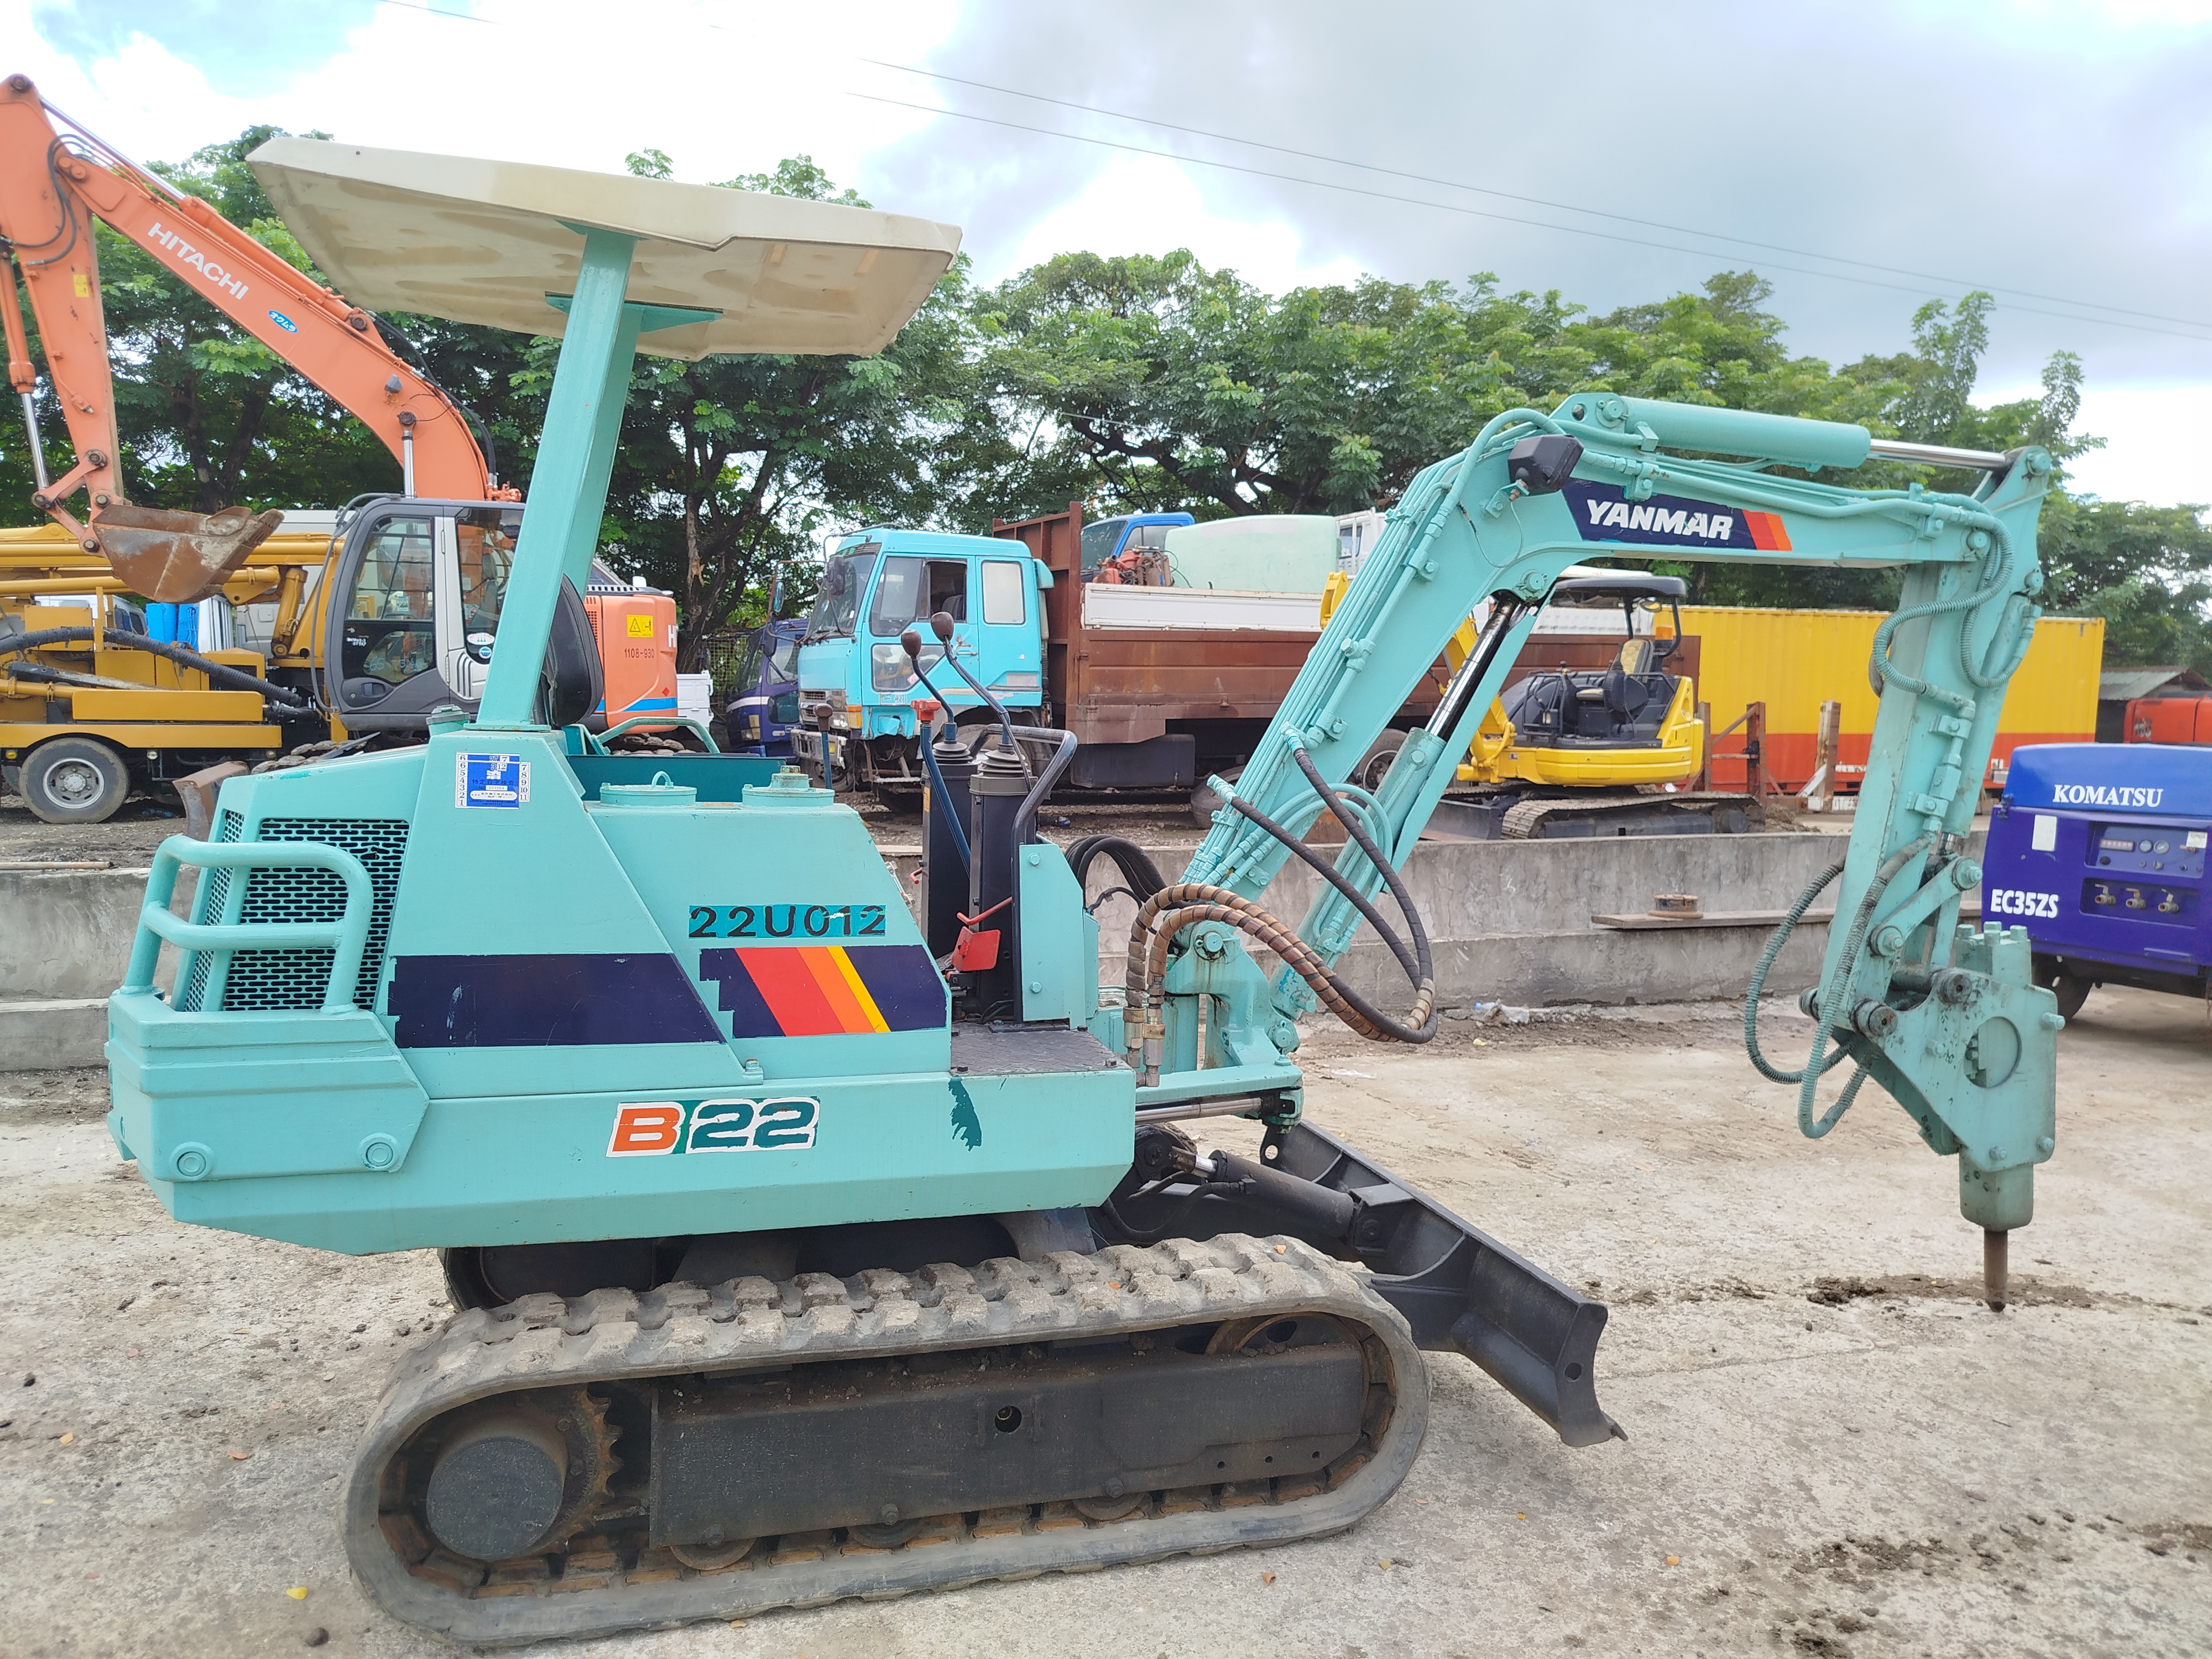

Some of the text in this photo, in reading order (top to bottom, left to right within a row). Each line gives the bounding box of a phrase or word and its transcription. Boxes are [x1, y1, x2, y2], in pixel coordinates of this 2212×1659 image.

[148, 222, 249, 300] HITACHI
[270, 312, 296, 332] オクムラ
[1587, 499, 1733, 540] YANMAR
[624, 648, 654, 658] 1108-930
[2052, 784, 2163, 807] KOMATSU
[1991, 888, 2058, 919] EC35ZS
[689, 905, 886, 937] 22U012
[607, 1097, 820, 1156] B22
